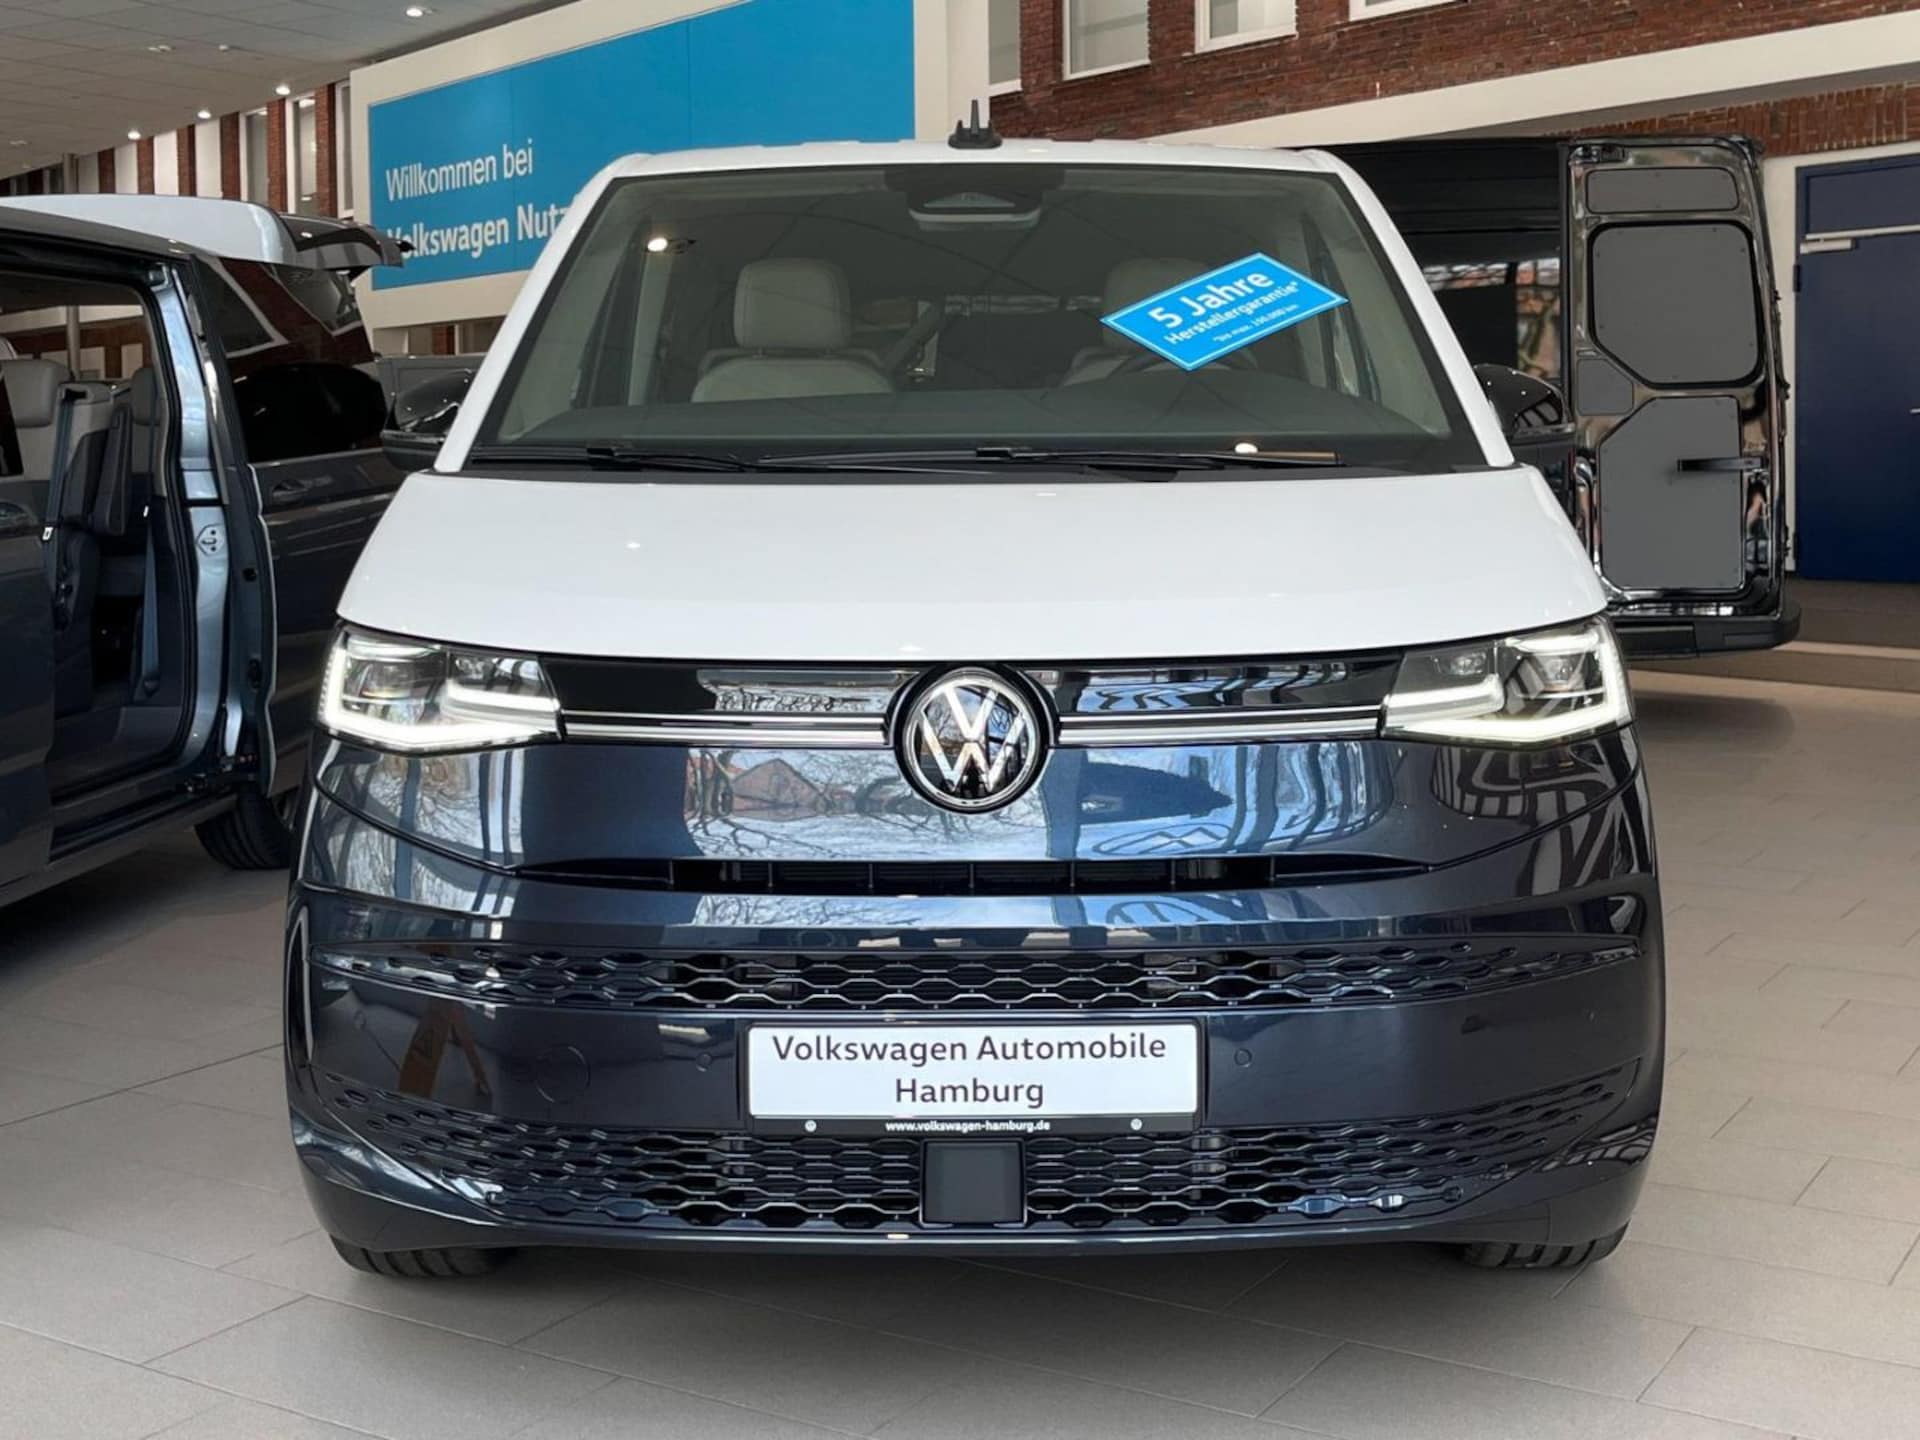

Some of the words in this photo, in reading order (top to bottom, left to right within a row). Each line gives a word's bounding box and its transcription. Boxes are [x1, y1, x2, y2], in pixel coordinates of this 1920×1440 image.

[386, 154, 496, 201] Willkommen
[503, 138, 533, 179] bei
[517, 203, 571, 241] Nut
[1147, 306, 1183, 329] 5
[1179, 271, 1274, 317] Jahre
[773, 1035, 967, 1067] Volkswagen
[977, 1033, 1166, 1061] Automobile
[896, 1078, 1044, 1108] Hamburg
[885, 1120, 1051, 1133] www.volkswagen-hamburg.de
